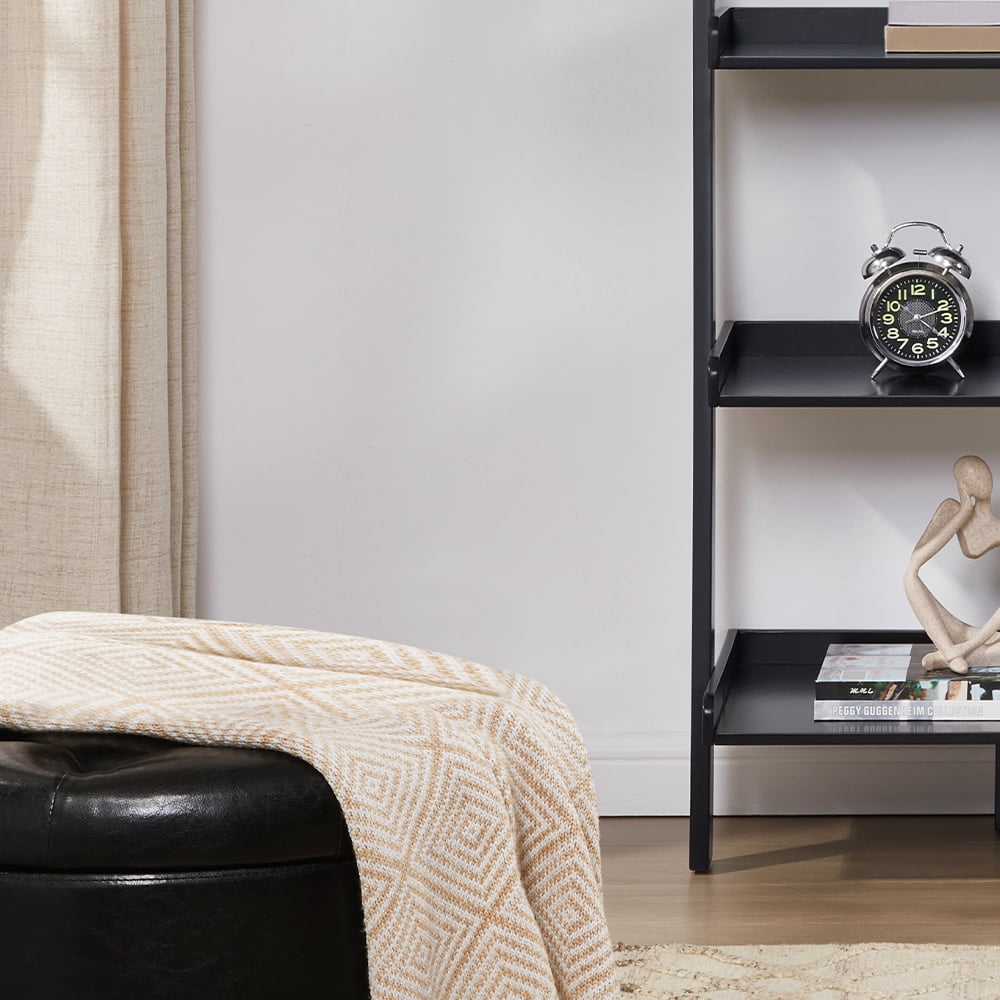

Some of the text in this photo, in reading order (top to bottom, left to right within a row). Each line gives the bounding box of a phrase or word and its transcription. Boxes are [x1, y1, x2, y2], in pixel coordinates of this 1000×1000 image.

[898, 289, 907, 300] 11
[910, 284, 926, 296] 12
[931, 288, 935, 300] 1
[886, 300, 900, 312] 10
[937, 300, 949, 311] 2
[882, 313, 894, 325] 9
[941, 313, 953, 324] 3
[887, 327, 899, 339] 8
[938, 327, 949, 339] 4
[897, 338, 909, 350] 7
[911, 343, 924, 354] 6
[927, 337, 939, 349] 5
[832, 705, 862, 717] PEGGY
[863, 705, 925, 717] GUGGENHEIM
